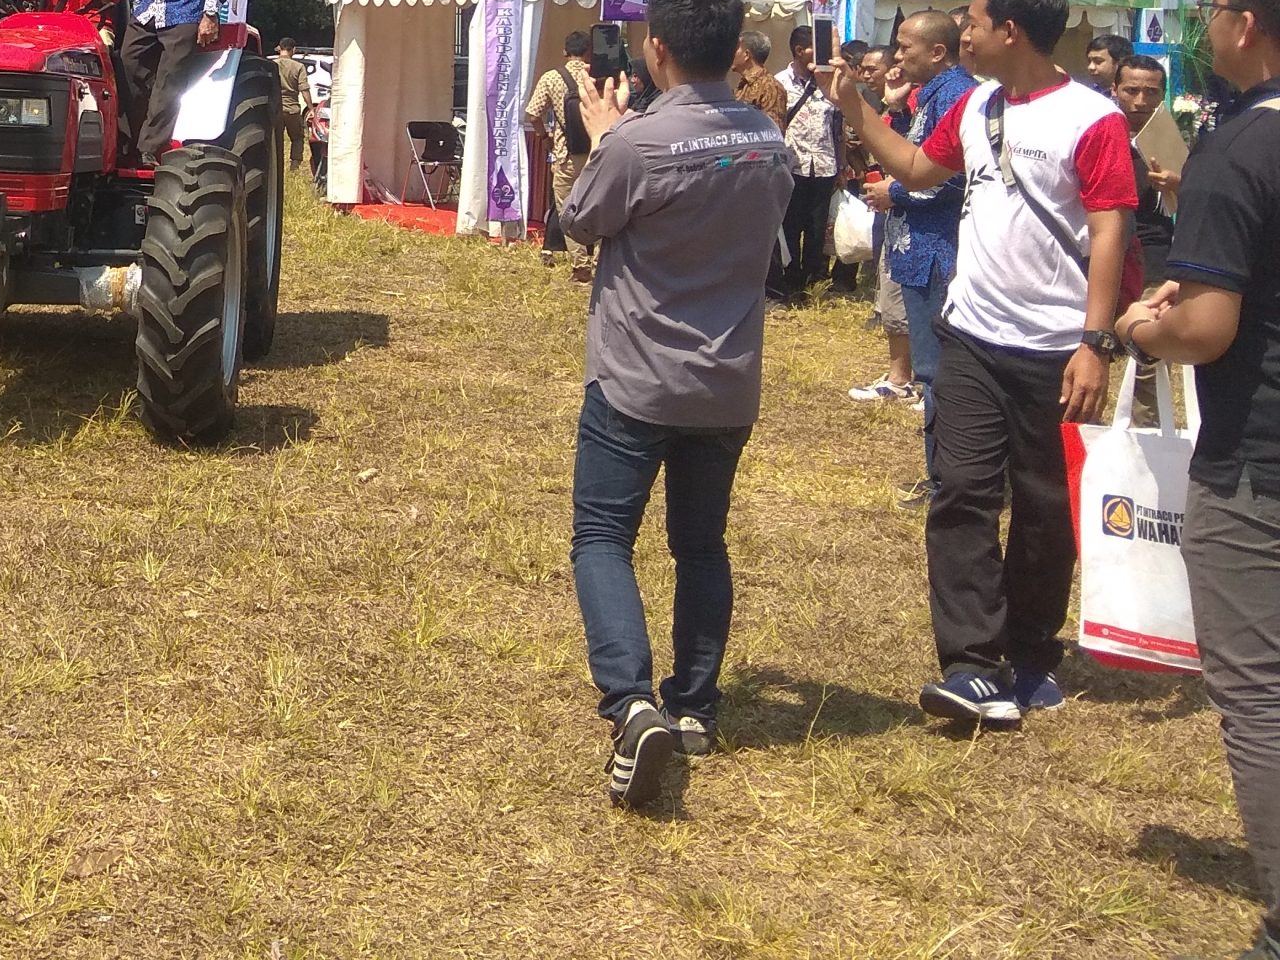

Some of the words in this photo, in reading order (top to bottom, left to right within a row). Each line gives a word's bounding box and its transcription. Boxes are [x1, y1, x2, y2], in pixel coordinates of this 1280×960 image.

[495, 8, 513, 92] KABUPATEN
[493, 100, 509, 157] SUBANG
[688, 135, 728, 152] INTRACO
[731, 131, 760, 145] PENTA
